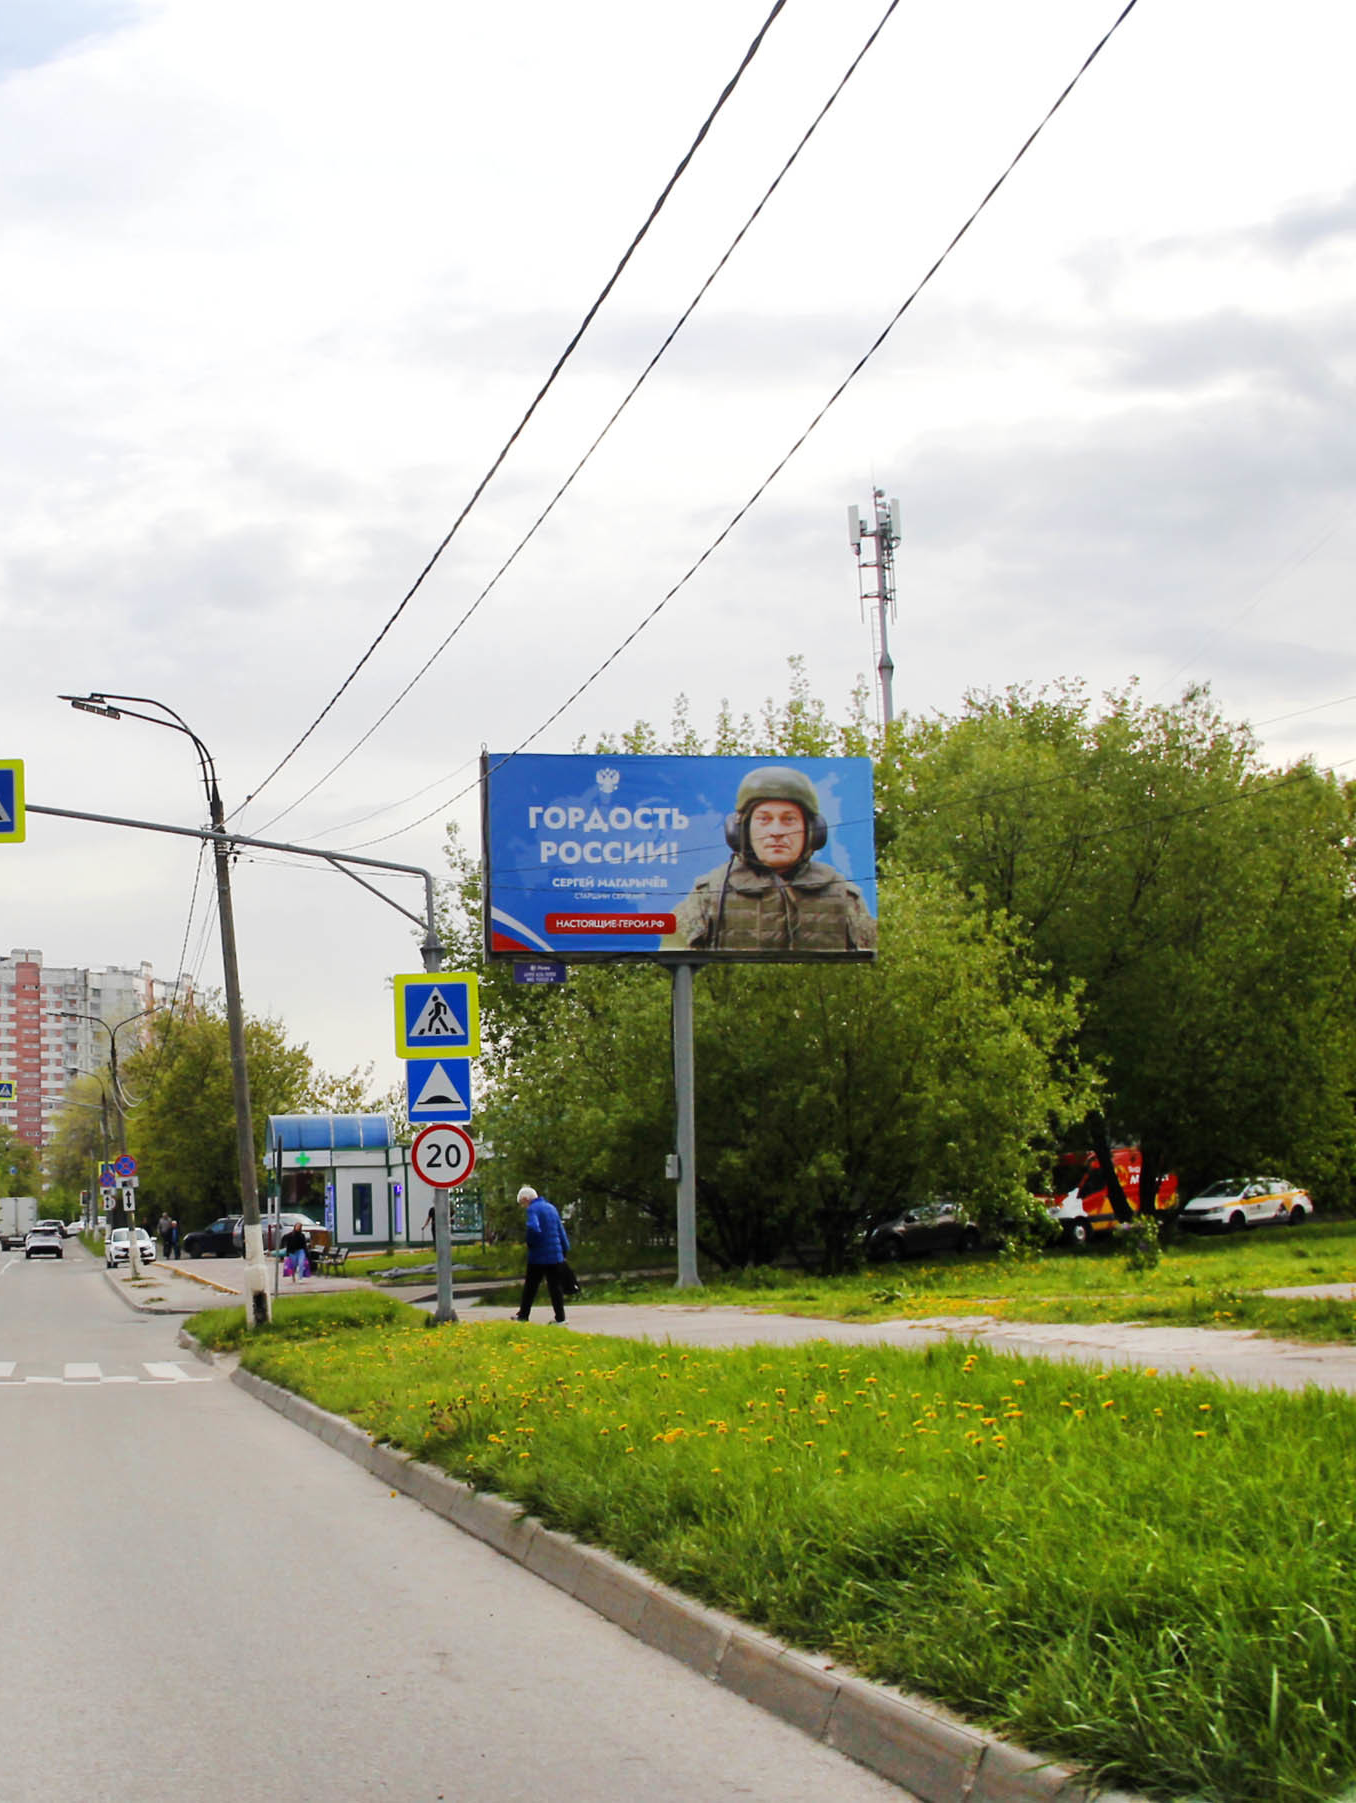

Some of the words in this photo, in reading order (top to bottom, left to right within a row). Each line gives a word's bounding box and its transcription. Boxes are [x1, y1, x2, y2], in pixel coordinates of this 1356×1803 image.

[528, 806, 689, 833] ГОРДОСТЬ
[540, 840, 679, 864] РОССИИ!
[552, 876, 595, 888] СЕРГЕЙ
[555, 919, 666, 929] НАСТОЯЩИЕ-ГЕРОИ.РФ
[426, 1143, 461, 1168] 20
